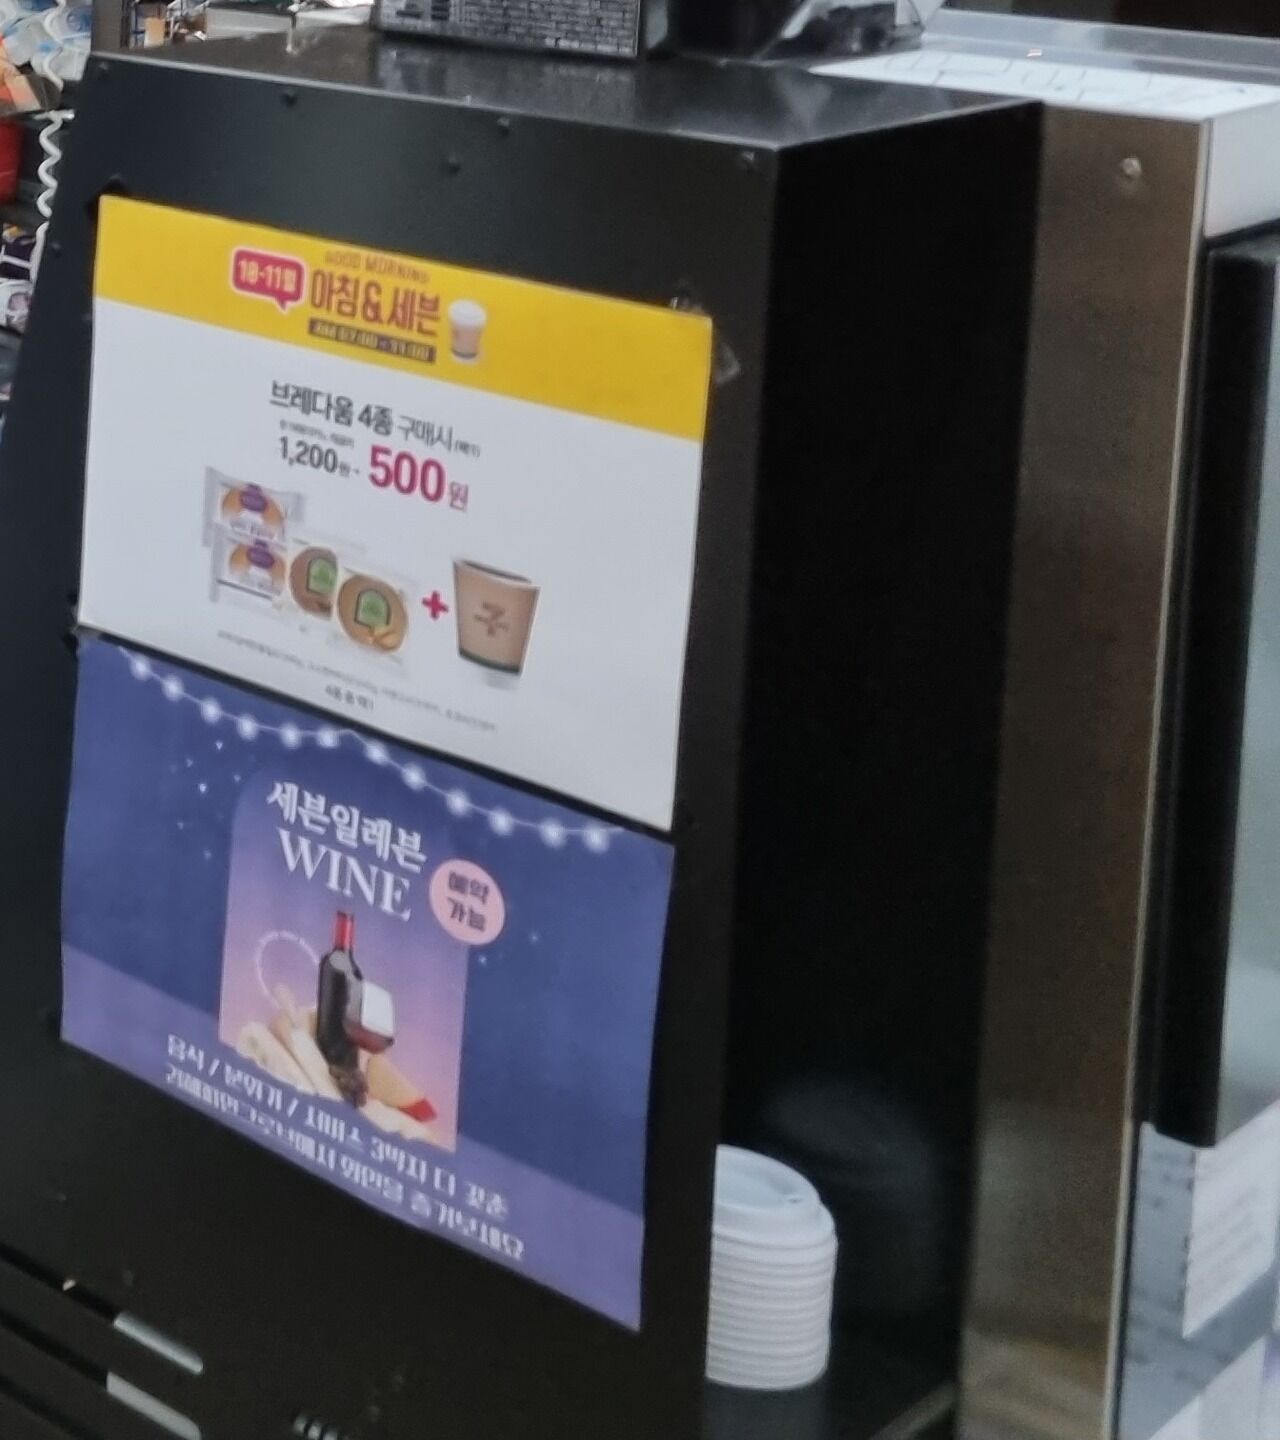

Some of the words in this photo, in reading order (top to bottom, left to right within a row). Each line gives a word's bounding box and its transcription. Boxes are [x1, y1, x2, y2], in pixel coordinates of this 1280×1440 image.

[269, 379, 354, 428] 브레다움
[357, 403, 393, 437] 4종
[266, 780, 429, 875] 세븐일레븐
[276, 825, 412, 923] WINE
